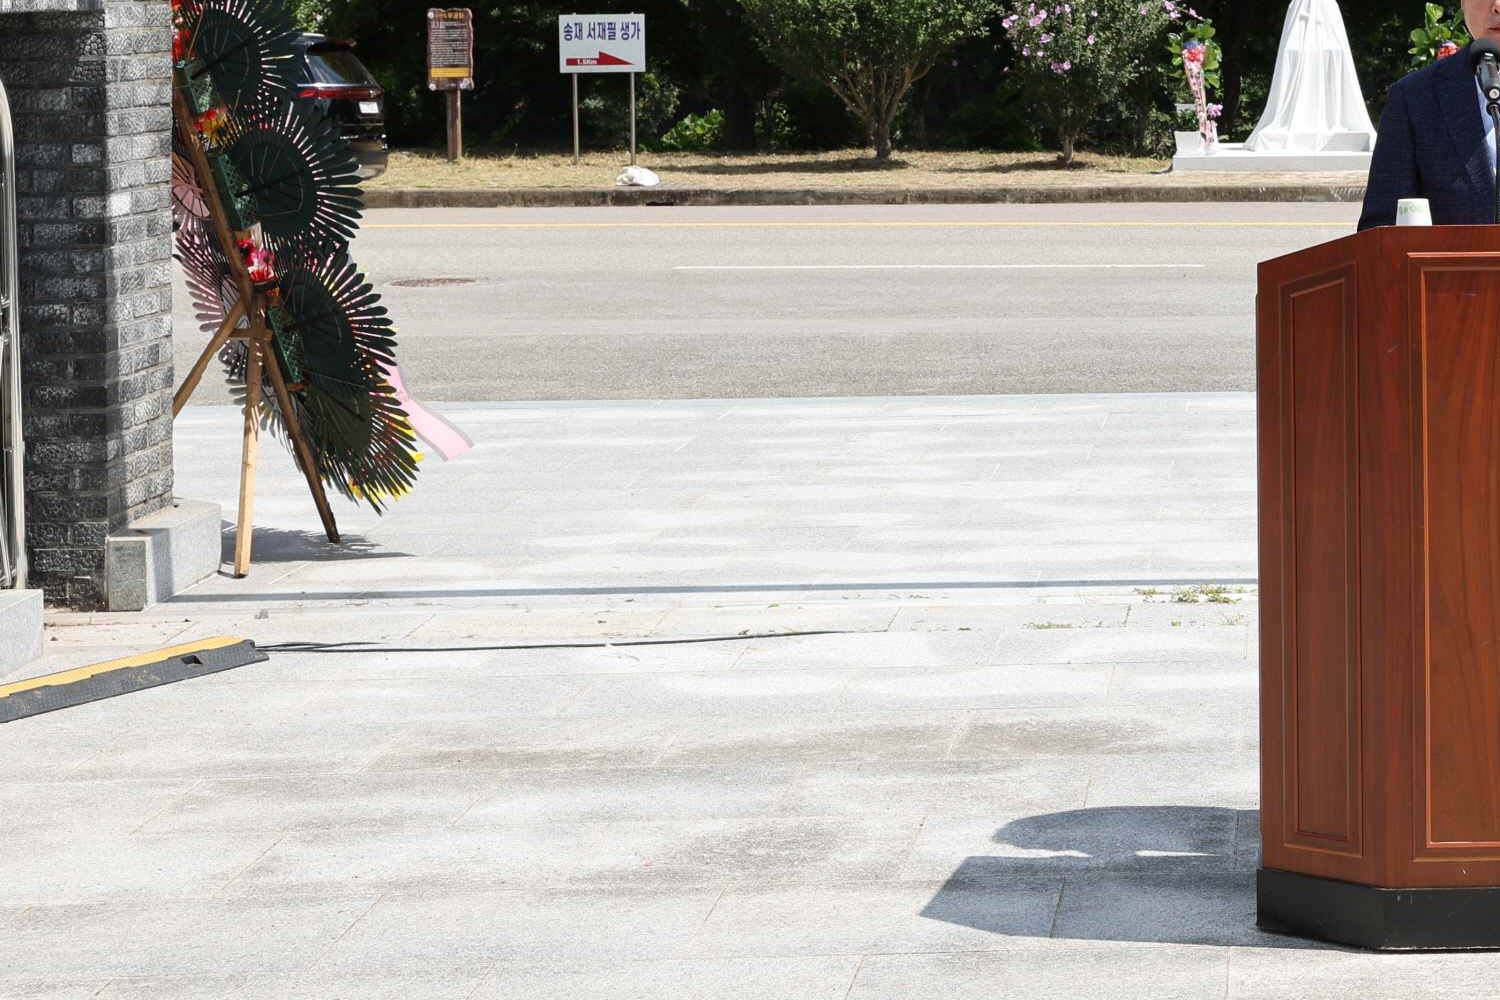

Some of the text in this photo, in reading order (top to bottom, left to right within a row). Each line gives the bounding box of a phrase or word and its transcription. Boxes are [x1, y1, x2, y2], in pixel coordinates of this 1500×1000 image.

[563, 22, 641, 41] 송재 서재필 생가
